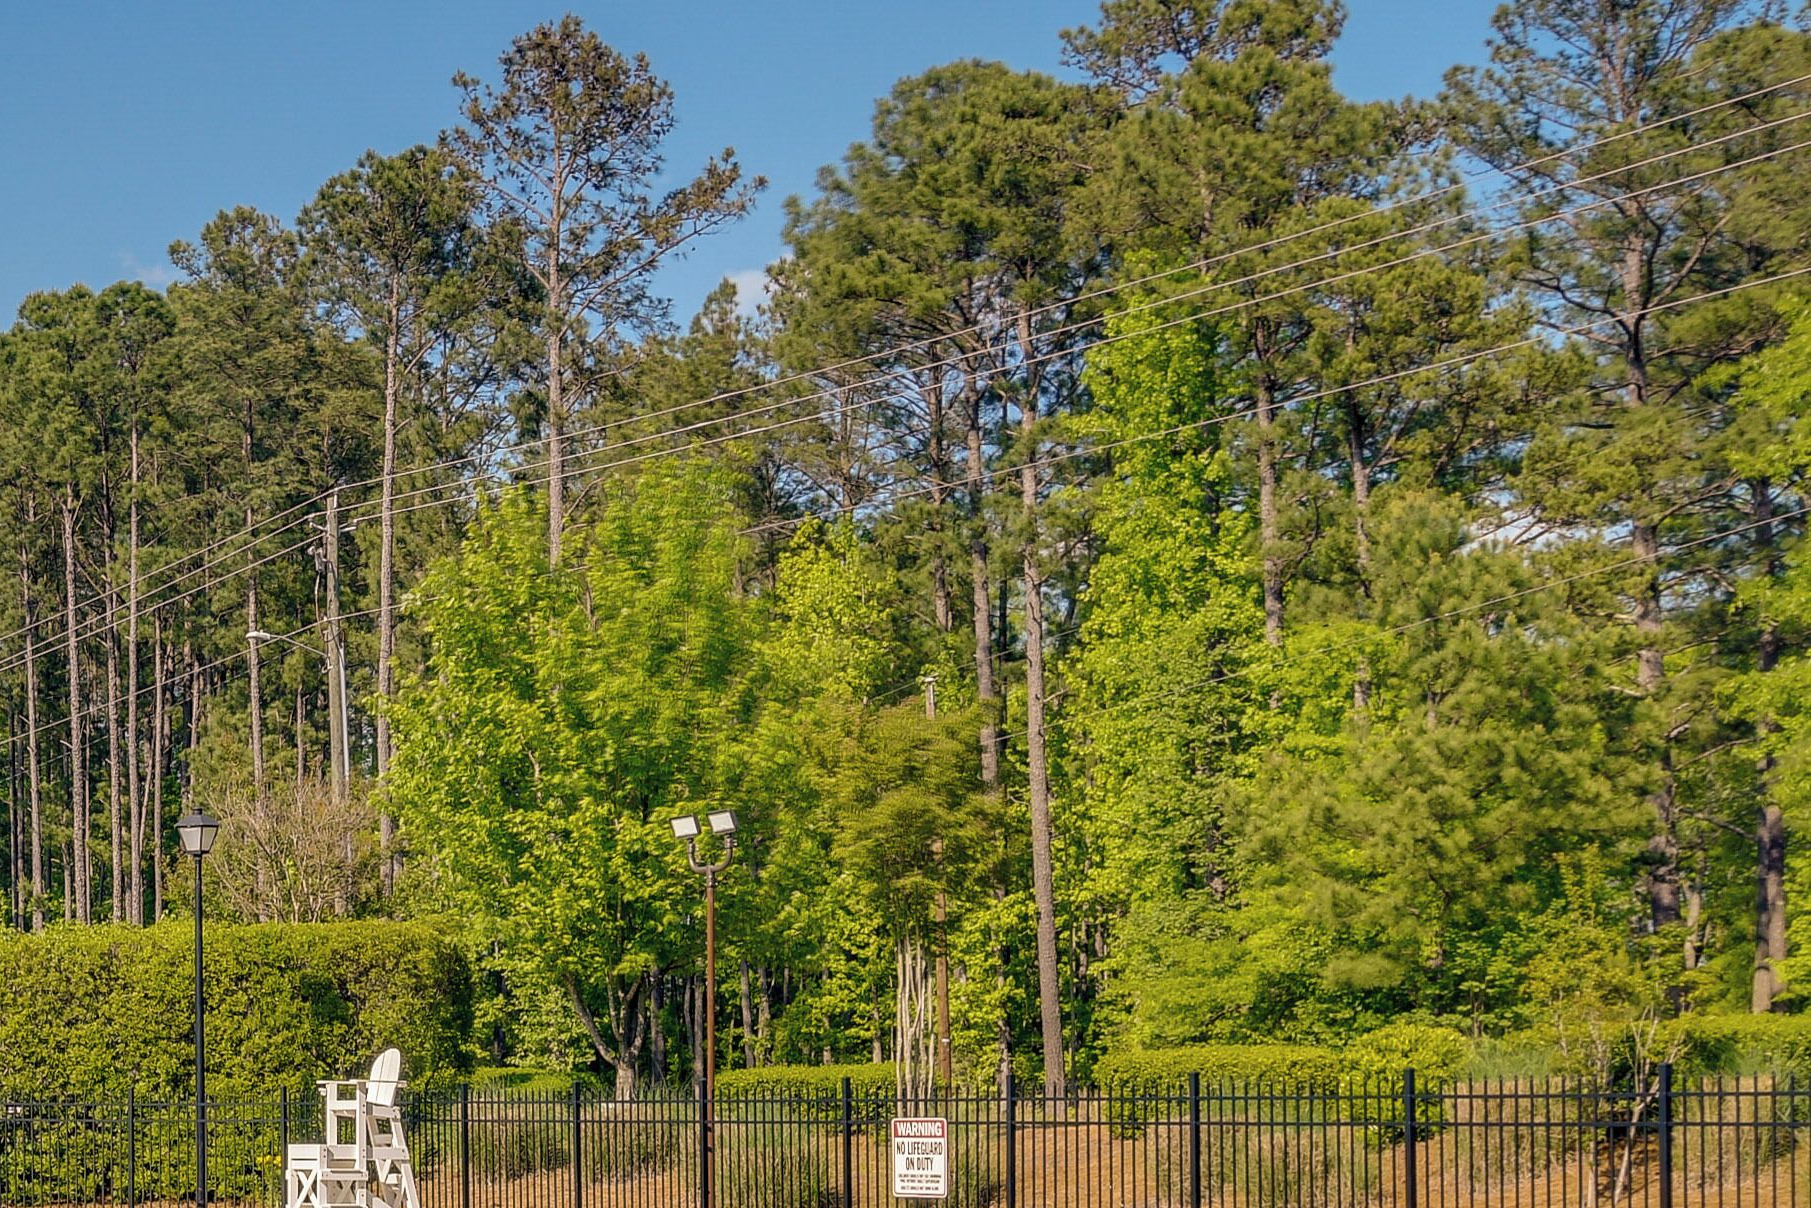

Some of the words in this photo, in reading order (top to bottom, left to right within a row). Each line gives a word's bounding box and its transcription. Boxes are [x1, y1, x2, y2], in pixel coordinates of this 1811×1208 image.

[896, 1122, 942, 1136] WARNING
[897, 1141, 905, 1155] NO
[907, 1141, 942, 1155] LIFEGUARD
[906, 1157, 914, 1170] ON
[917, 1157, 933, 1171] DUTY
